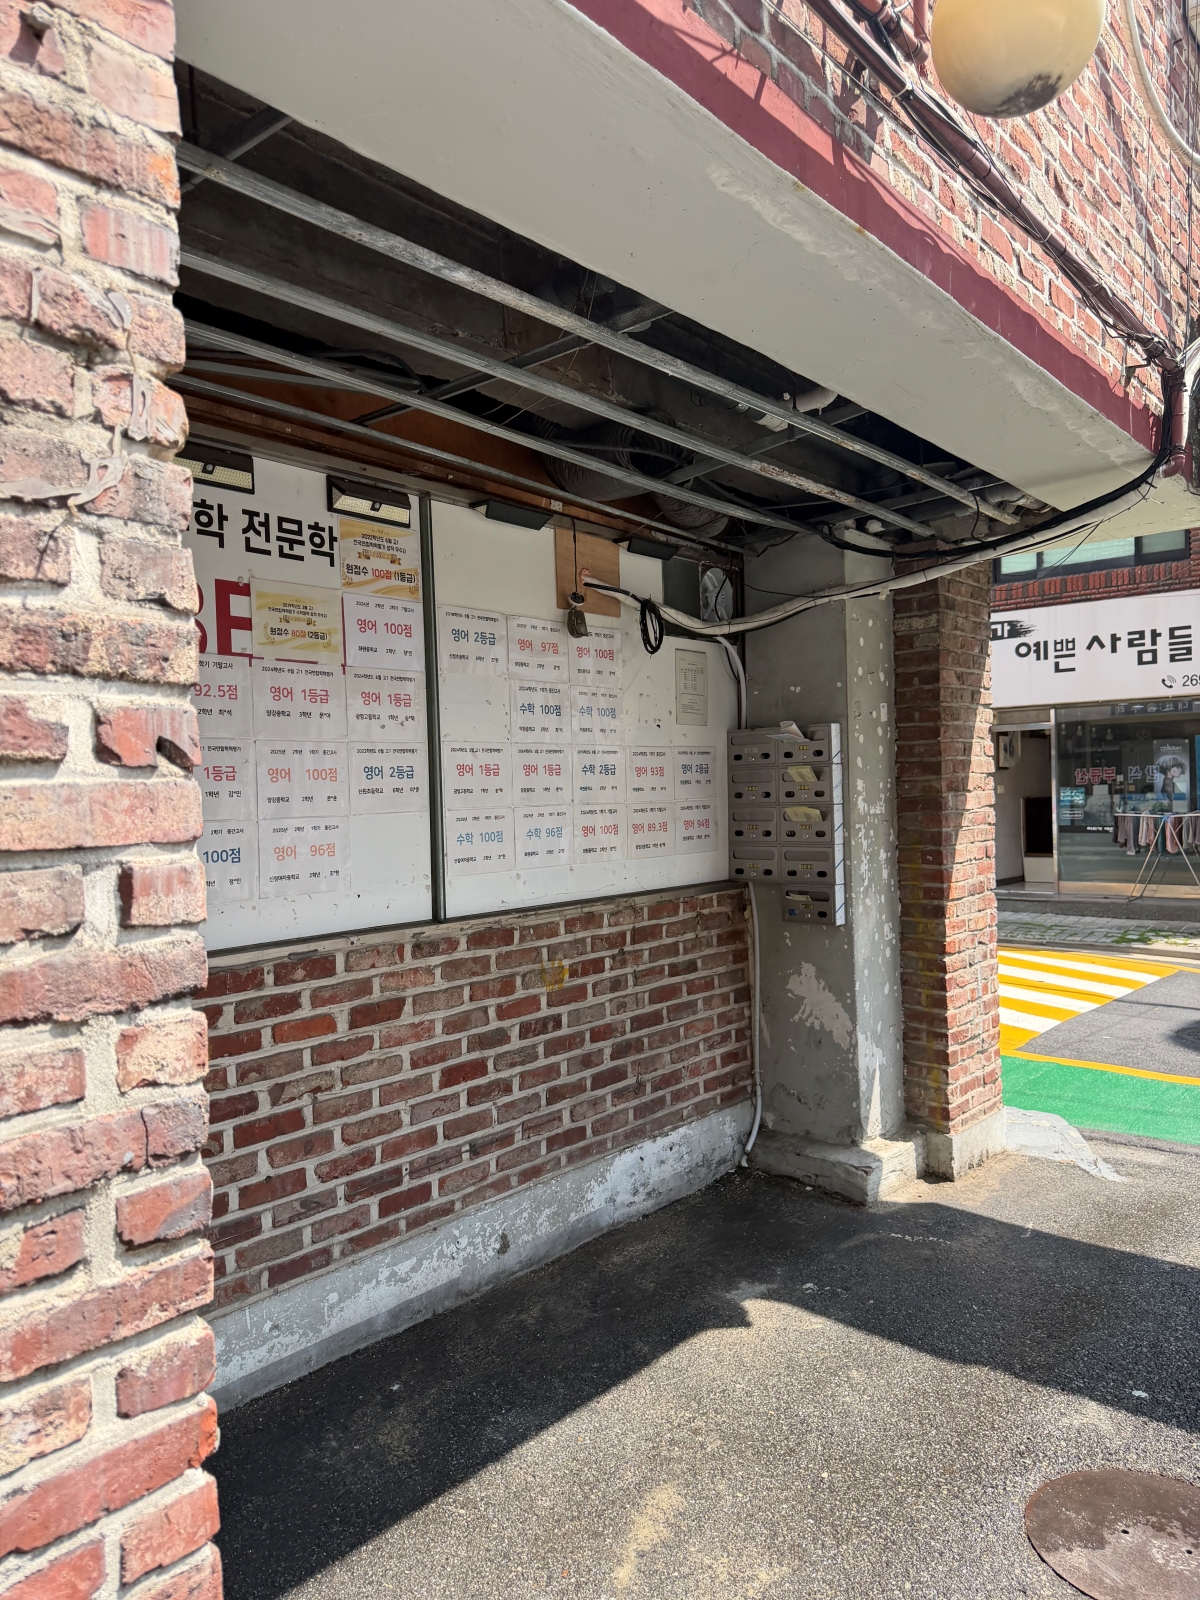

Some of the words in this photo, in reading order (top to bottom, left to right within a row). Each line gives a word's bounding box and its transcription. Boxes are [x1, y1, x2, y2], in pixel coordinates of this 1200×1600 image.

[187, 499, 228, 548] 학
[242, 508, 338, 567] 전문학
[346, 564, 368, 576] 원점수
[371, 568, 391, 580] 100점
[394, 571, 416, 583] (1등급)
[357, 619, 377, 634] 영어
[384, 622, 412, 638] 100점
[452, 629, 469, 643] 영어
[474, 632, 496, 645] 2등급
[518, 639, 533, 651] 영어
[541, 642, 558, 654] 97점
[576, 647, 590, 658] 영어
[594, 649, 614, 661] 100점
[199, 660, 209, 668] 학기
[212, 661, 233, 669] 기말고사
[1182, 674, 1200, 687] 26
[194, 684, 238, 700] 92.5점
[270, 686, 293, 702] 영어
[301, 688, 329, 704] 1등급
[361, 691, 380, 706] 영어
[387, 693, 412, 707] 1등급
[520, 703, 535, 715] 수학
[540, 704, 561, 716] 100점
[579, 706, 593, 717] 수학
[597, 707, 616, 719] 100점
[203, 765, 237, 782] 1등급
[267, 767, 291, 783] 영어
[305, 767, 337, 782] 100점
[364, 765, 383, 780] 영어
[389, 765, 414, 779] 2등급
[456, 763, 473, 776] 영어
[479, 764, 500, 776] 1등급
[523, 764, 538, 776] 영어
[543, 764, 561, 776] 1등급
[582, 764, 596, 775] 수학
[599, 764, 616, 775] 2등급
[635, 766, 647, 777] 영어
[651, 766, 664, 777] 93점
[682, 764, 692, 774] 영어
[695, 764, 709, 774] 2등급
[582, 825, 596, 837] 영어
[600, 824, 618, 835] 100점
[632, 823, 644, 834] 영어
[648, 821, 668, 832] 89.3점
[683, 819, 694, 830] 영어
[697, 818, 710, 829] 94점
[457, 832, 474, 845] 수학
[479, 830, 503, 843] 100점
[526, 828, 541, 840] 수학
[546, 826, 562, 838] 96점
[203, 847, 241, 863] 100점
[274, 845, 296, 862] 영어
[310, 842, 335, 857] 96점
